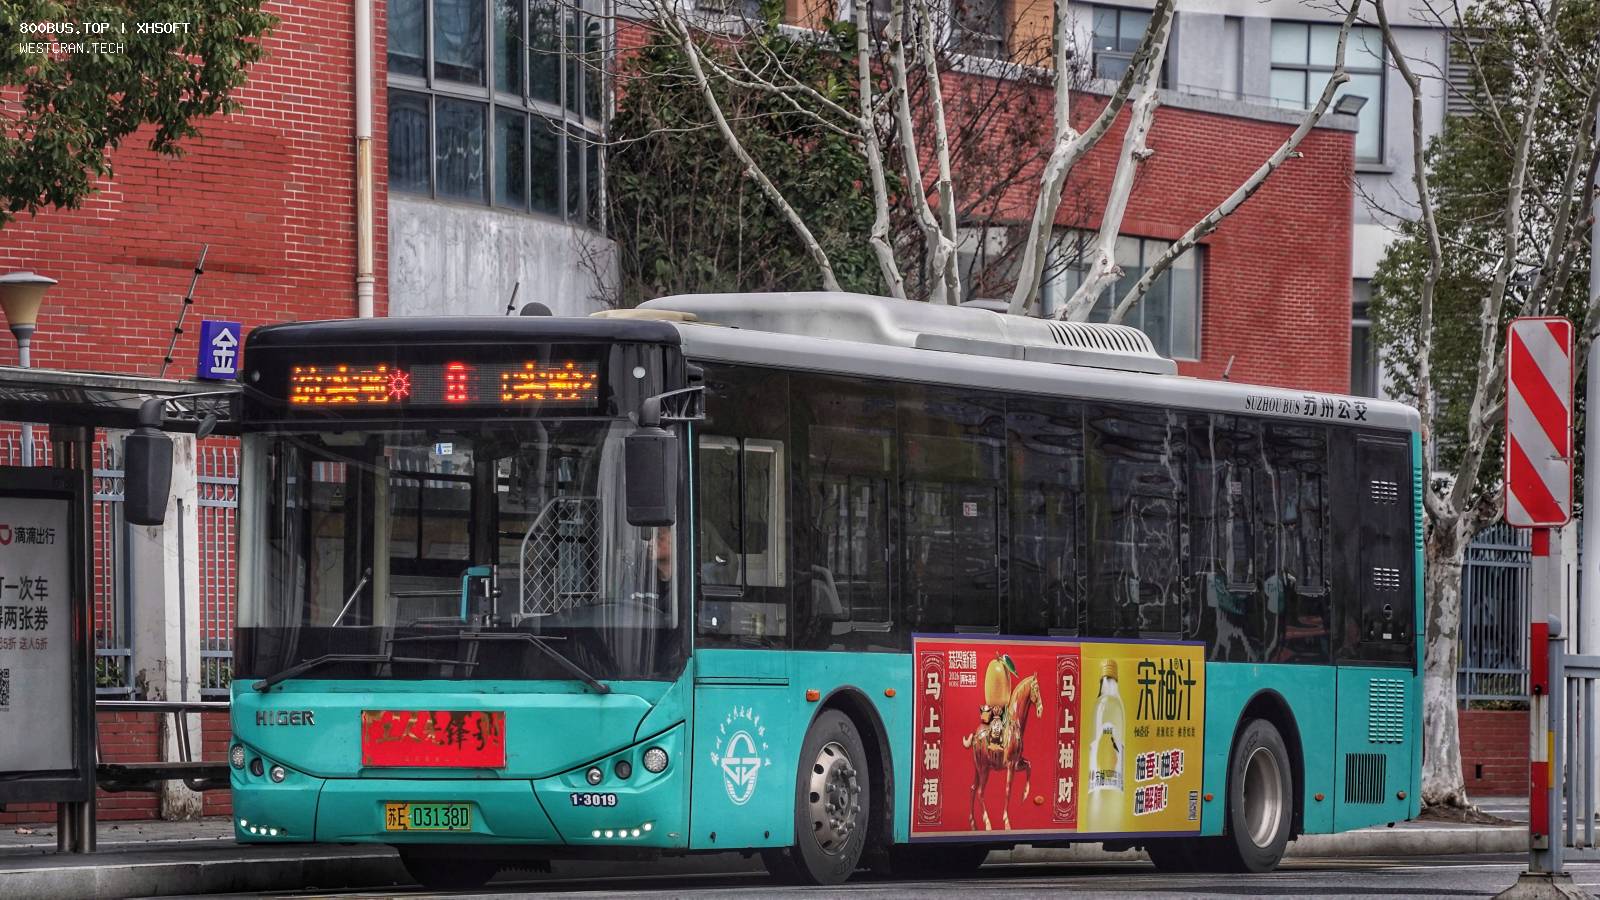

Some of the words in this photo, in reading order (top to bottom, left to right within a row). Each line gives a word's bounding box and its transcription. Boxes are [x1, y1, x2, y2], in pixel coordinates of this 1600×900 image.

[211, 327, 239, 374] 金
[1245, 394, 1282, 413] SUZHOU
[1282, 399, 1300, 415] BUS
[1303, 395, 1368, 421] 苏州公交
[14, 526, 56, 546] 滴滴出行
[0, 605, 49, 632] 两张券
[255, 709, 316, 727] HIGER
[922, 671, 941, 806] 马上柚福
[1057, 674, 1076, 804] 马上柚财
[413, 807, 470, 827] 03138D
